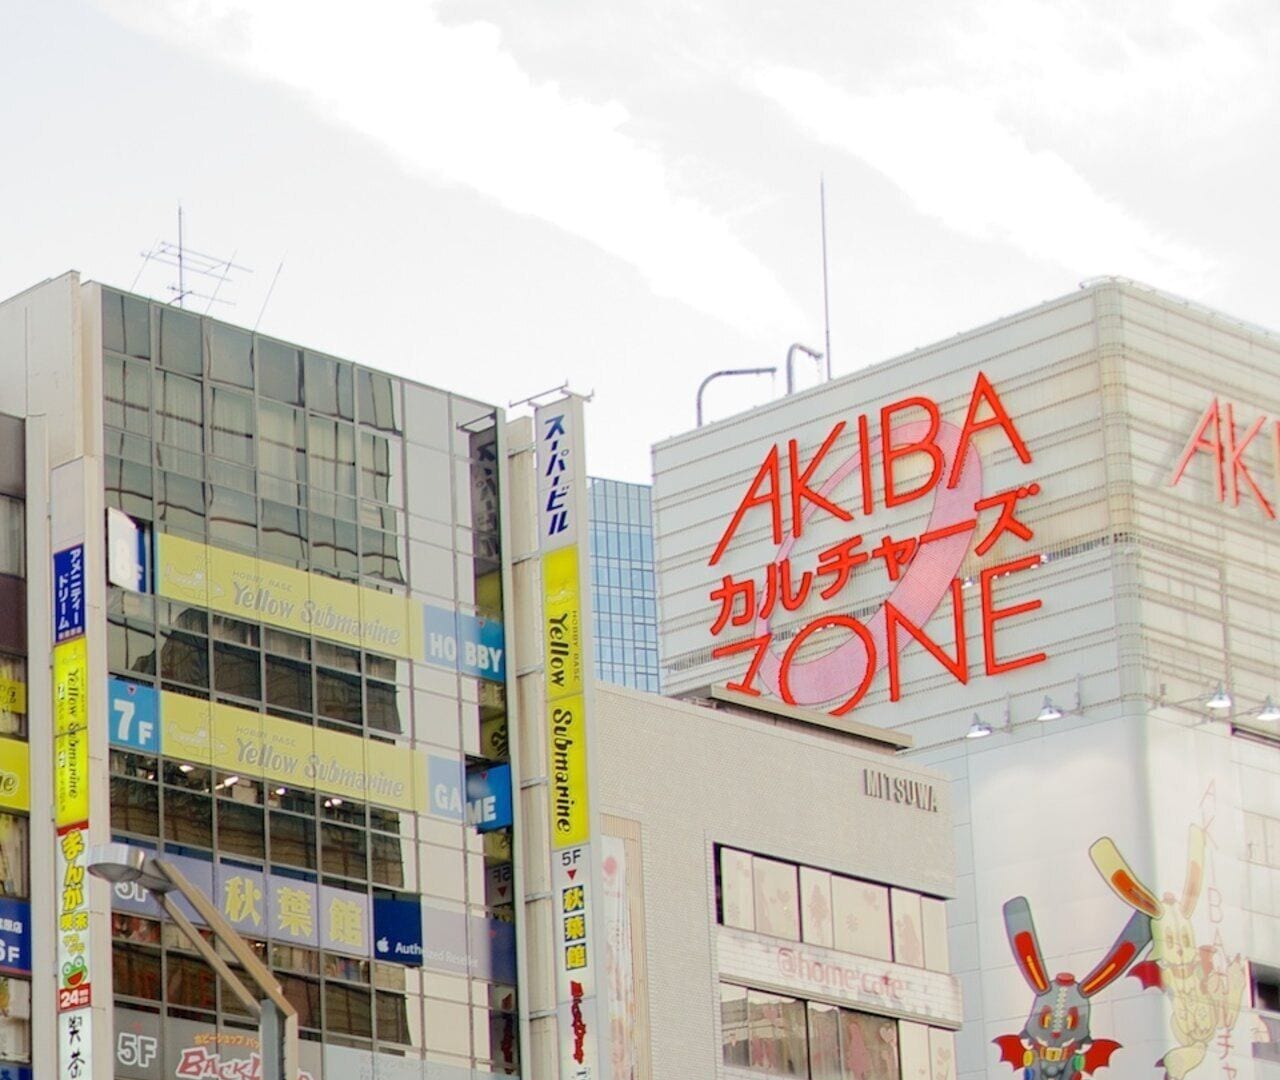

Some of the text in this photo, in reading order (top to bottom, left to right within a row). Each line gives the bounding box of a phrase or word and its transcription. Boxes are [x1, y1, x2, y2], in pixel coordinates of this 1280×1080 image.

[544, 414, 569, 536] スーパービル
[708, 371, 1032, 566] AKIBA
[69, 548, 82, 626] アメニティー
[710, 483, 1041, 636] カルチャーズ
[58, 574, 70, 630] ドリーム
[232, 580, 401, 647] Yellow Submarine
[429, 633, 503, 674] HOBBY
[712, 556, 1048, 717] ZONE
[113, 700, 154, 745] 7F
[547, 612, 572, 833] Yellow Submarine
[236, 737, 405, 799] Yellow Submarine
[863, 767, 939, 814] MITSUWA
[434, 783, 497, 826] GAME
[60, 829, 86, 911] まんが
[562, 849, 581, 867] 5F
[59, 912, 89, 932] 喫茶
[224, 875, 364, 948] 秋葉館
[563, 886, 587, 970] 秋葉館
[776, 946, 904, 1001] @home cafe
[117, 1032, 158, 1068] 5F
